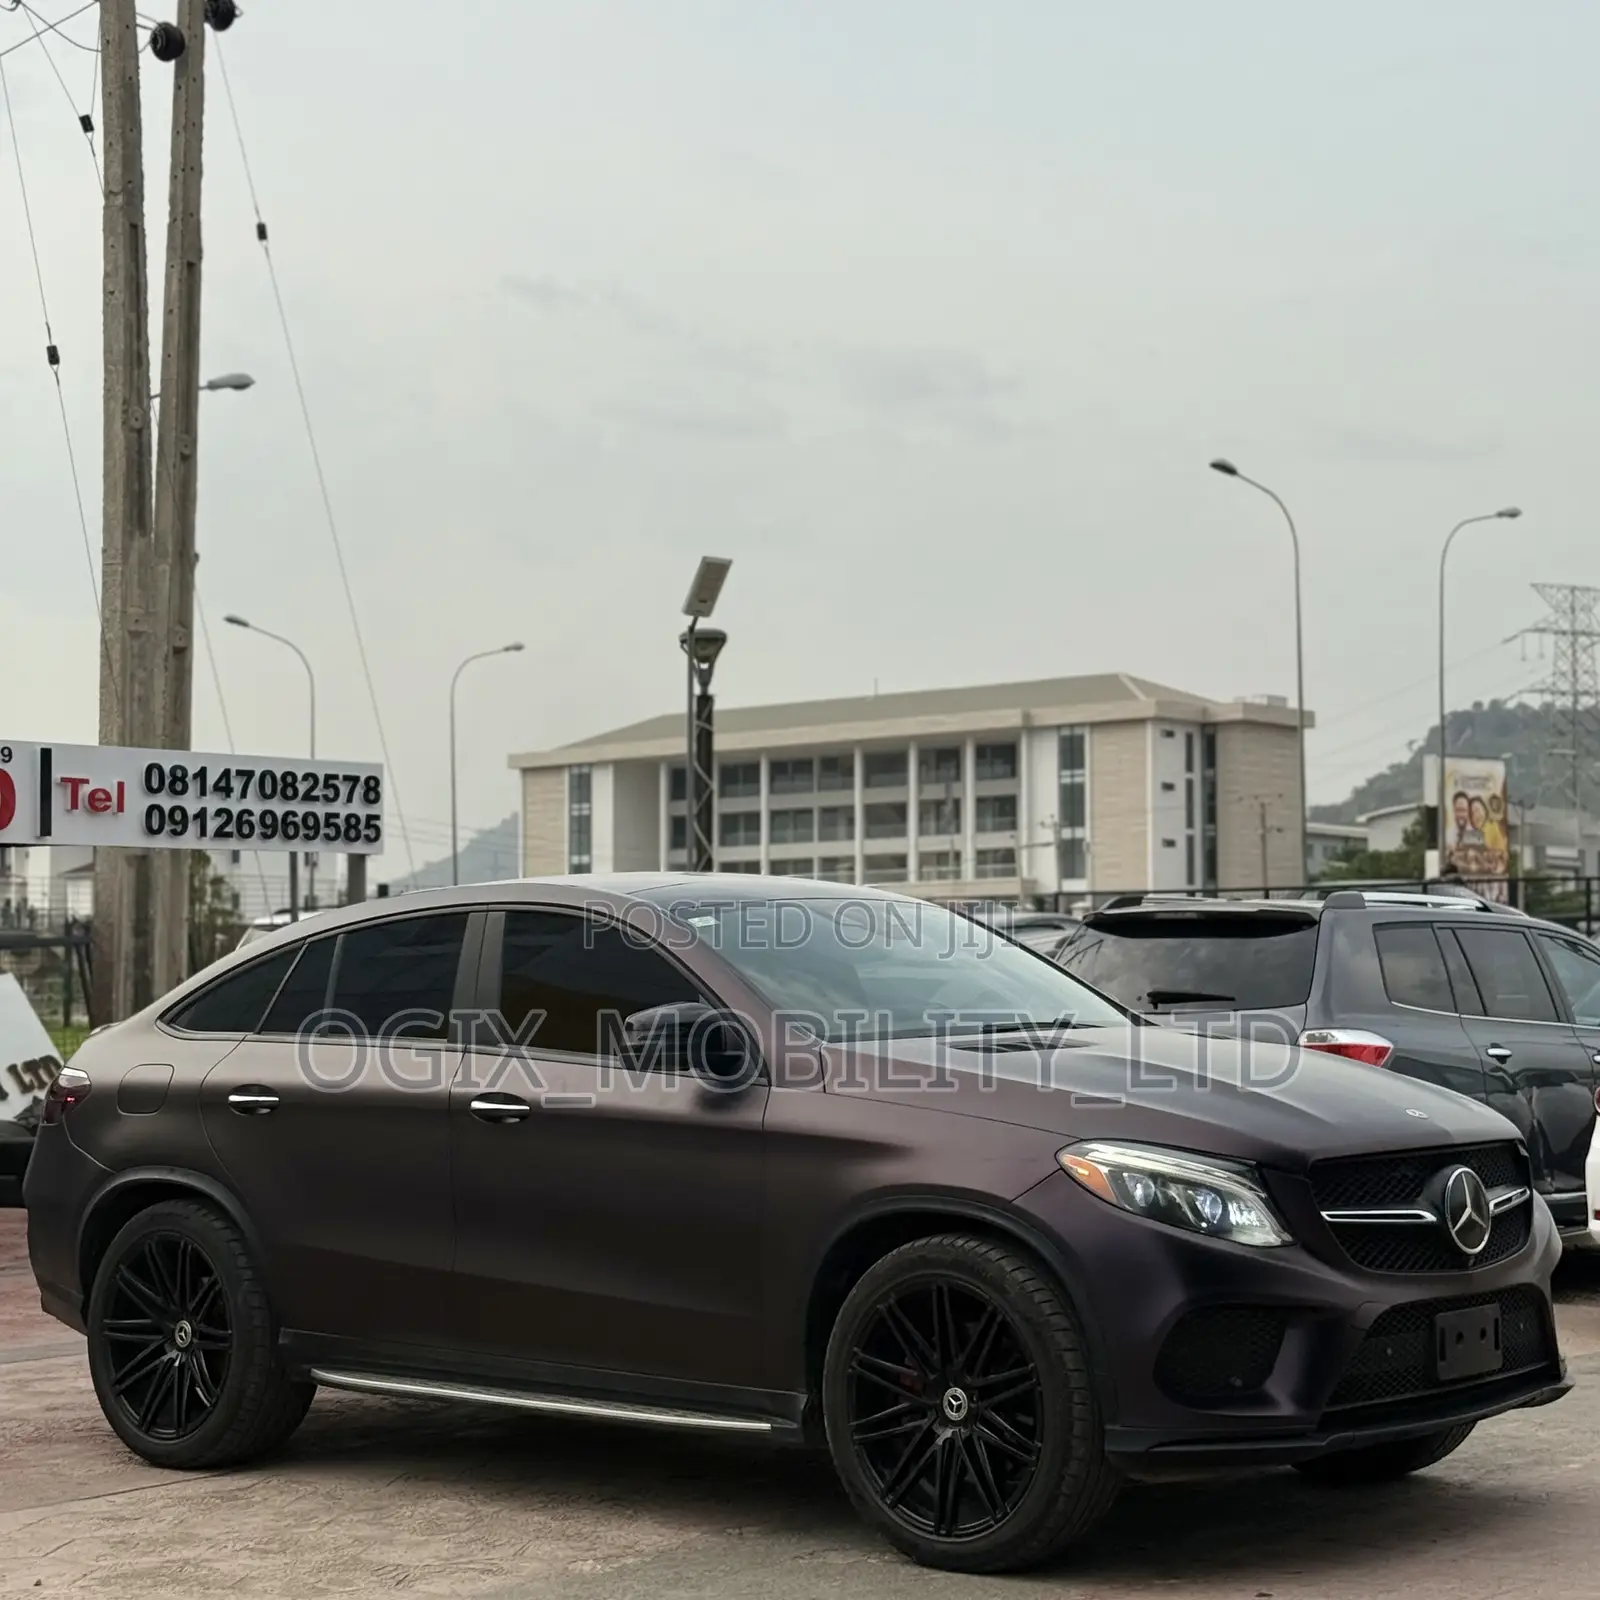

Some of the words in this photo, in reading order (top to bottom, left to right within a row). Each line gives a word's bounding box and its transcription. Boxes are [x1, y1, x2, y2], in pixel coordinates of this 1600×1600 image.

[59, 776, 125, 813] Tel
[143, 762, 381, 805] 08147082578
[144, 803, 381, 844] 09126969585
